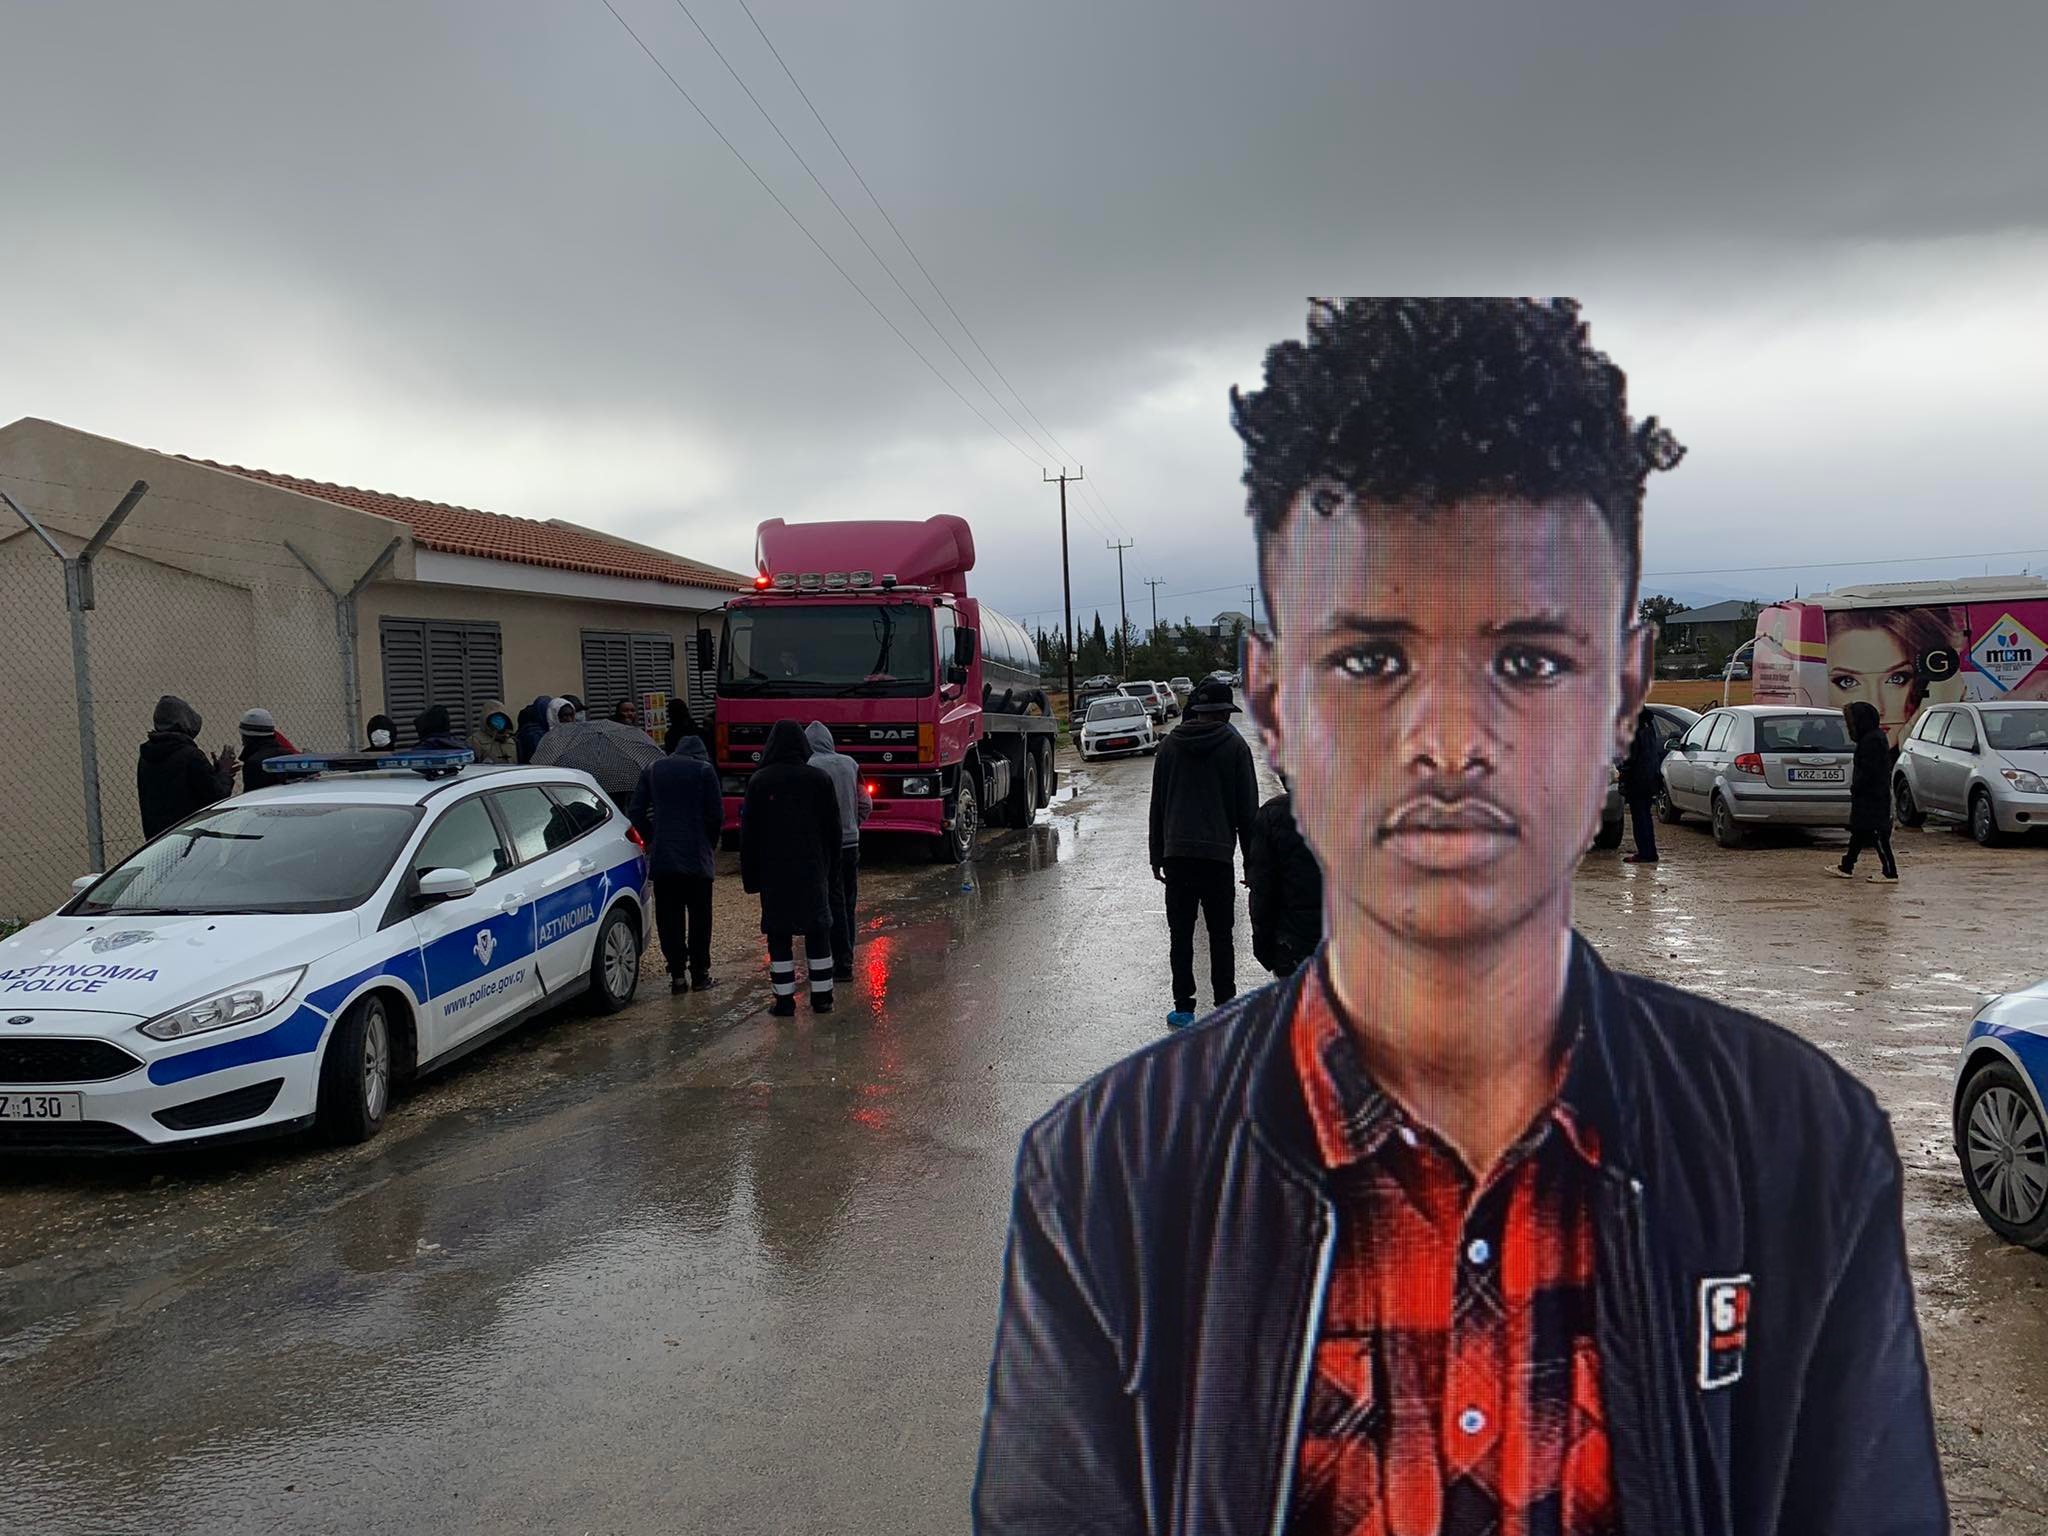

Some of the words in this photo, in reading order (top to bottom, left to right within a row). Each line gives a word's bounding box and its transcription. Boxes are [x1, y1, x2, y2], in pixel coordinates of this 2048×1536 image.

[1926, 650, 1949, 672] G
[869, 730, 915, 739] DAF
[1797, 770, 1815, 779] KRZ
[1822, 770, 1840, 779] 165
[539, 903, 595, 944] ΑΣΤΥΝΟΜΙΑ
[4, 979, 108, 993] POLICE
[443, 968, 526, 1017] www.police.gov.cy
[22, 1096, 62, 1118] 130
